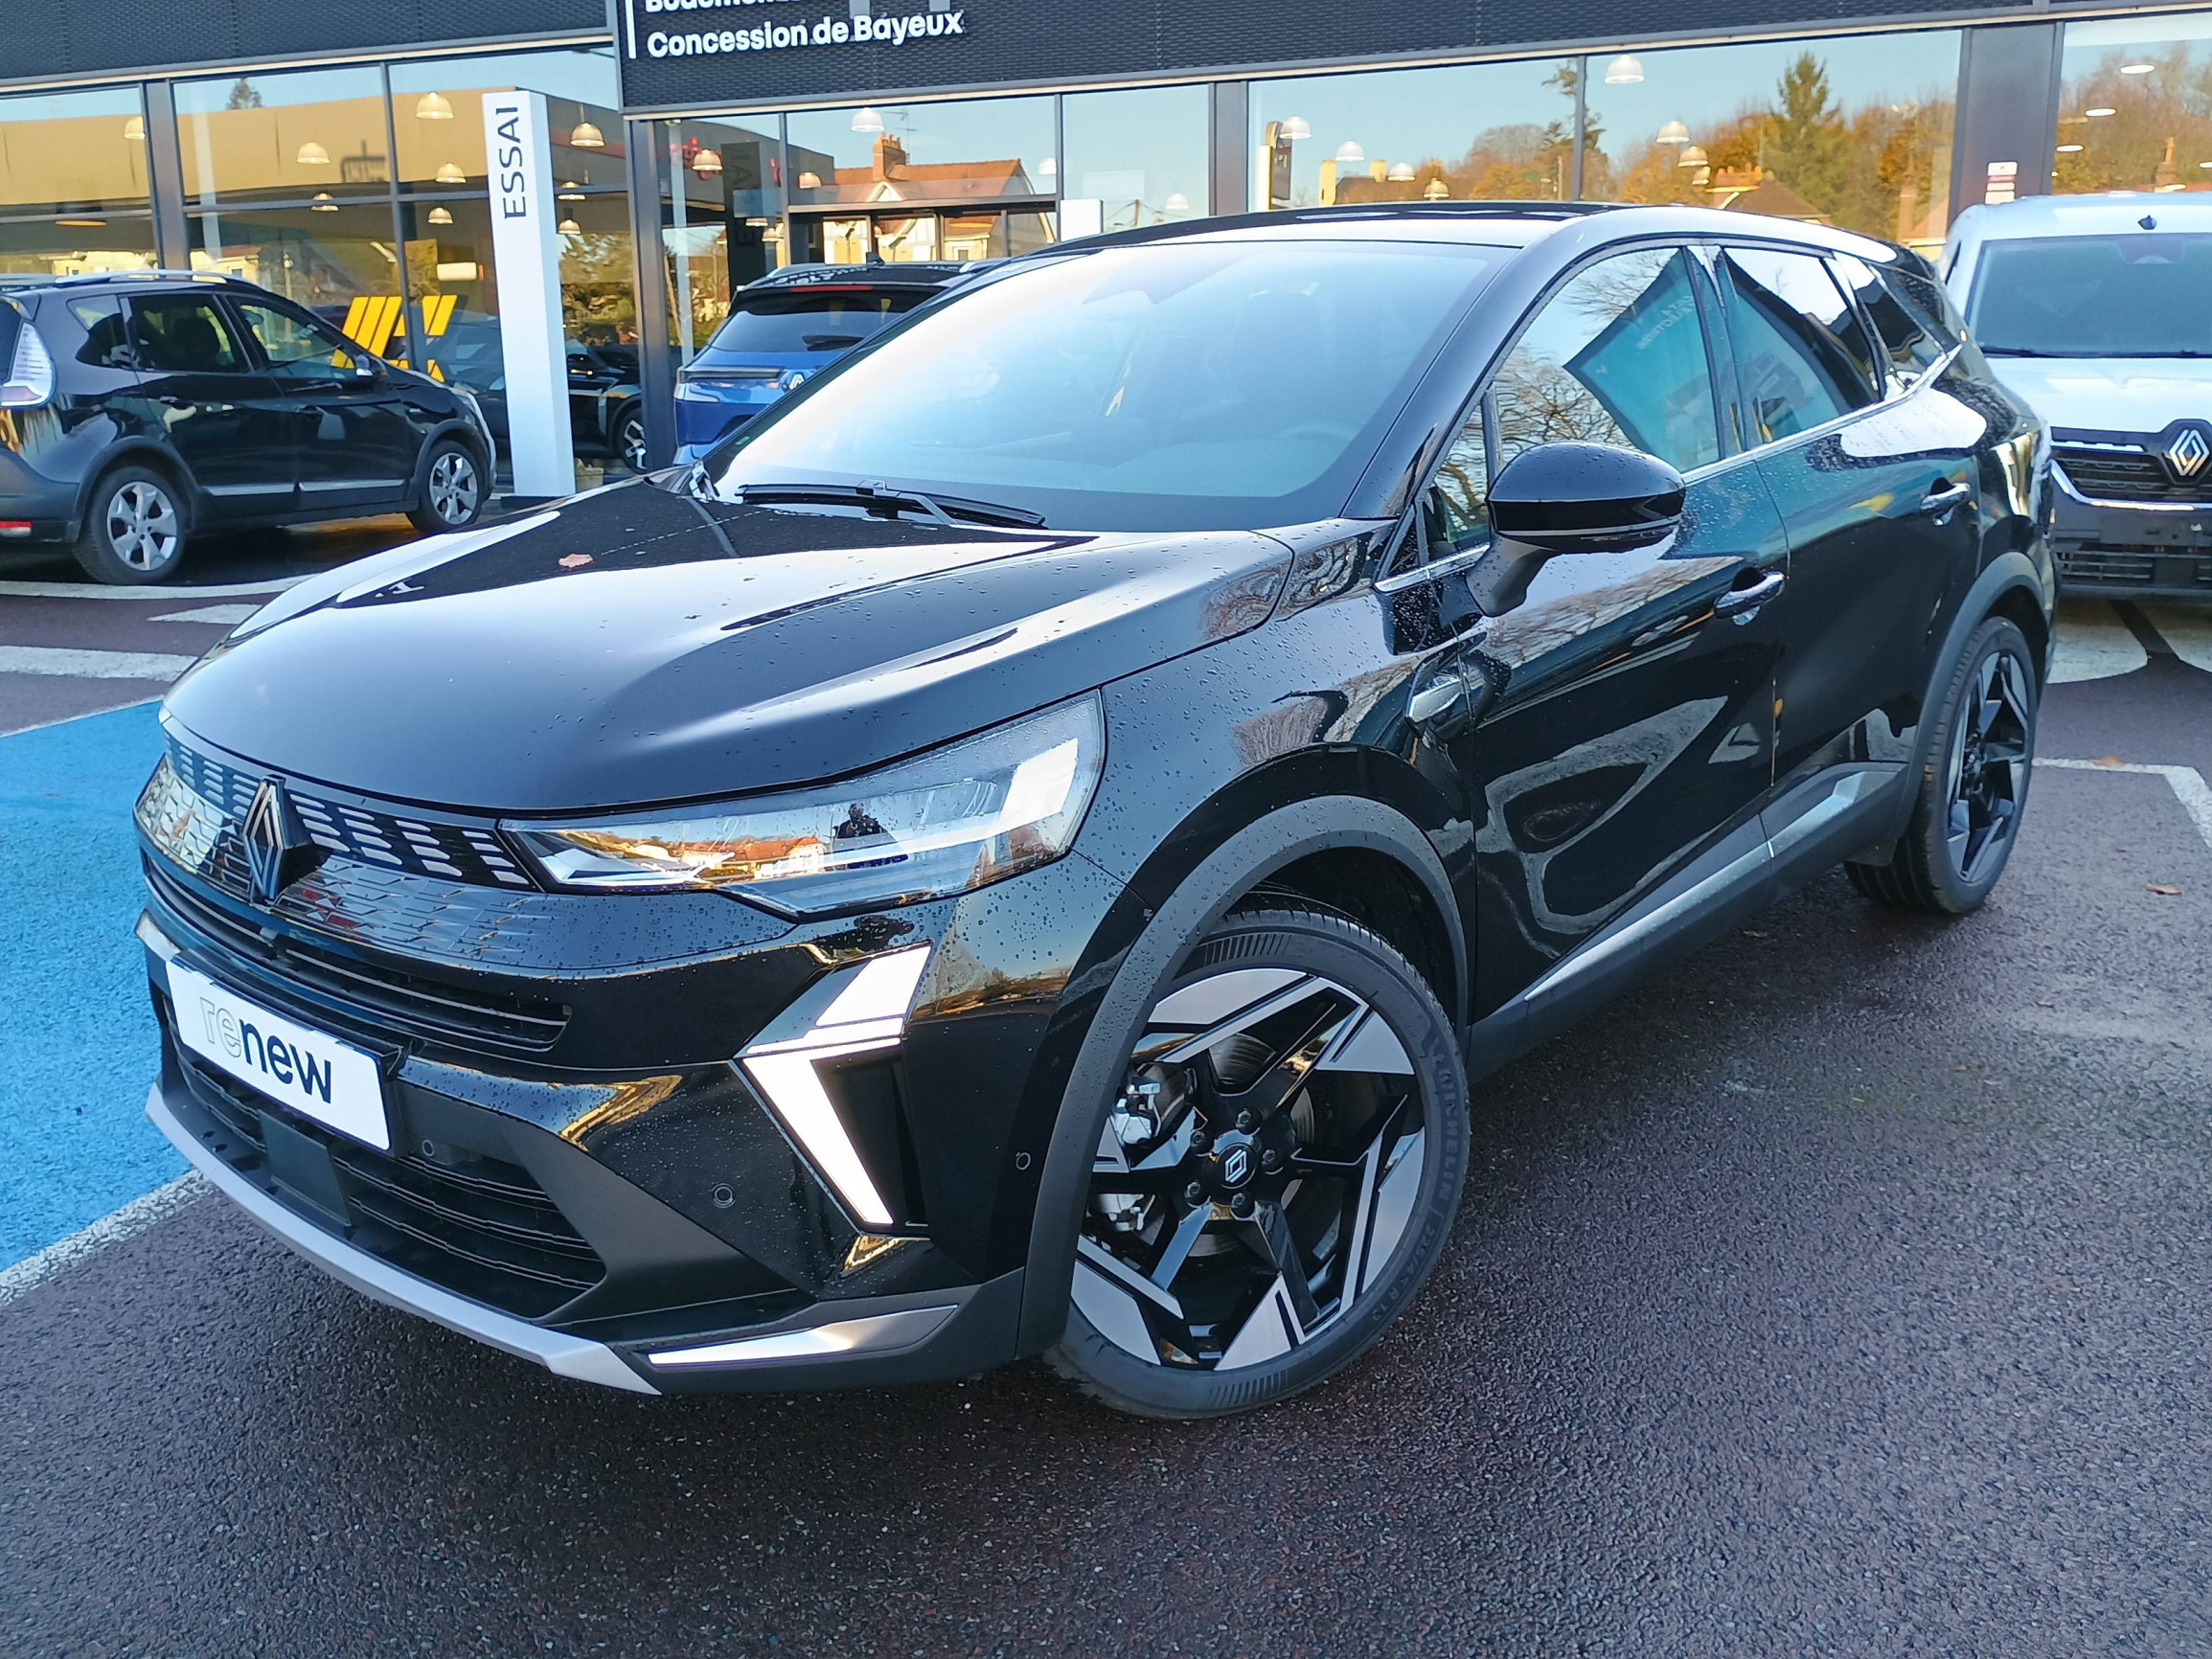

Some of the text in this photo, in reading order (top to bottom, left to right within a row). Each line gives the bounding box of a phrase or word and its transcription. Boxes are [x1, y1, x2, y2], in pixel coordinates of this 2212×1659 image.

[647, 11, 964, 58] Concession de Bayeux
[495, 106, 527, 219] ESSAI
[199, 996, 331, 1105] renew
[1437, 1067, 1458, 1201] MICHELIN
